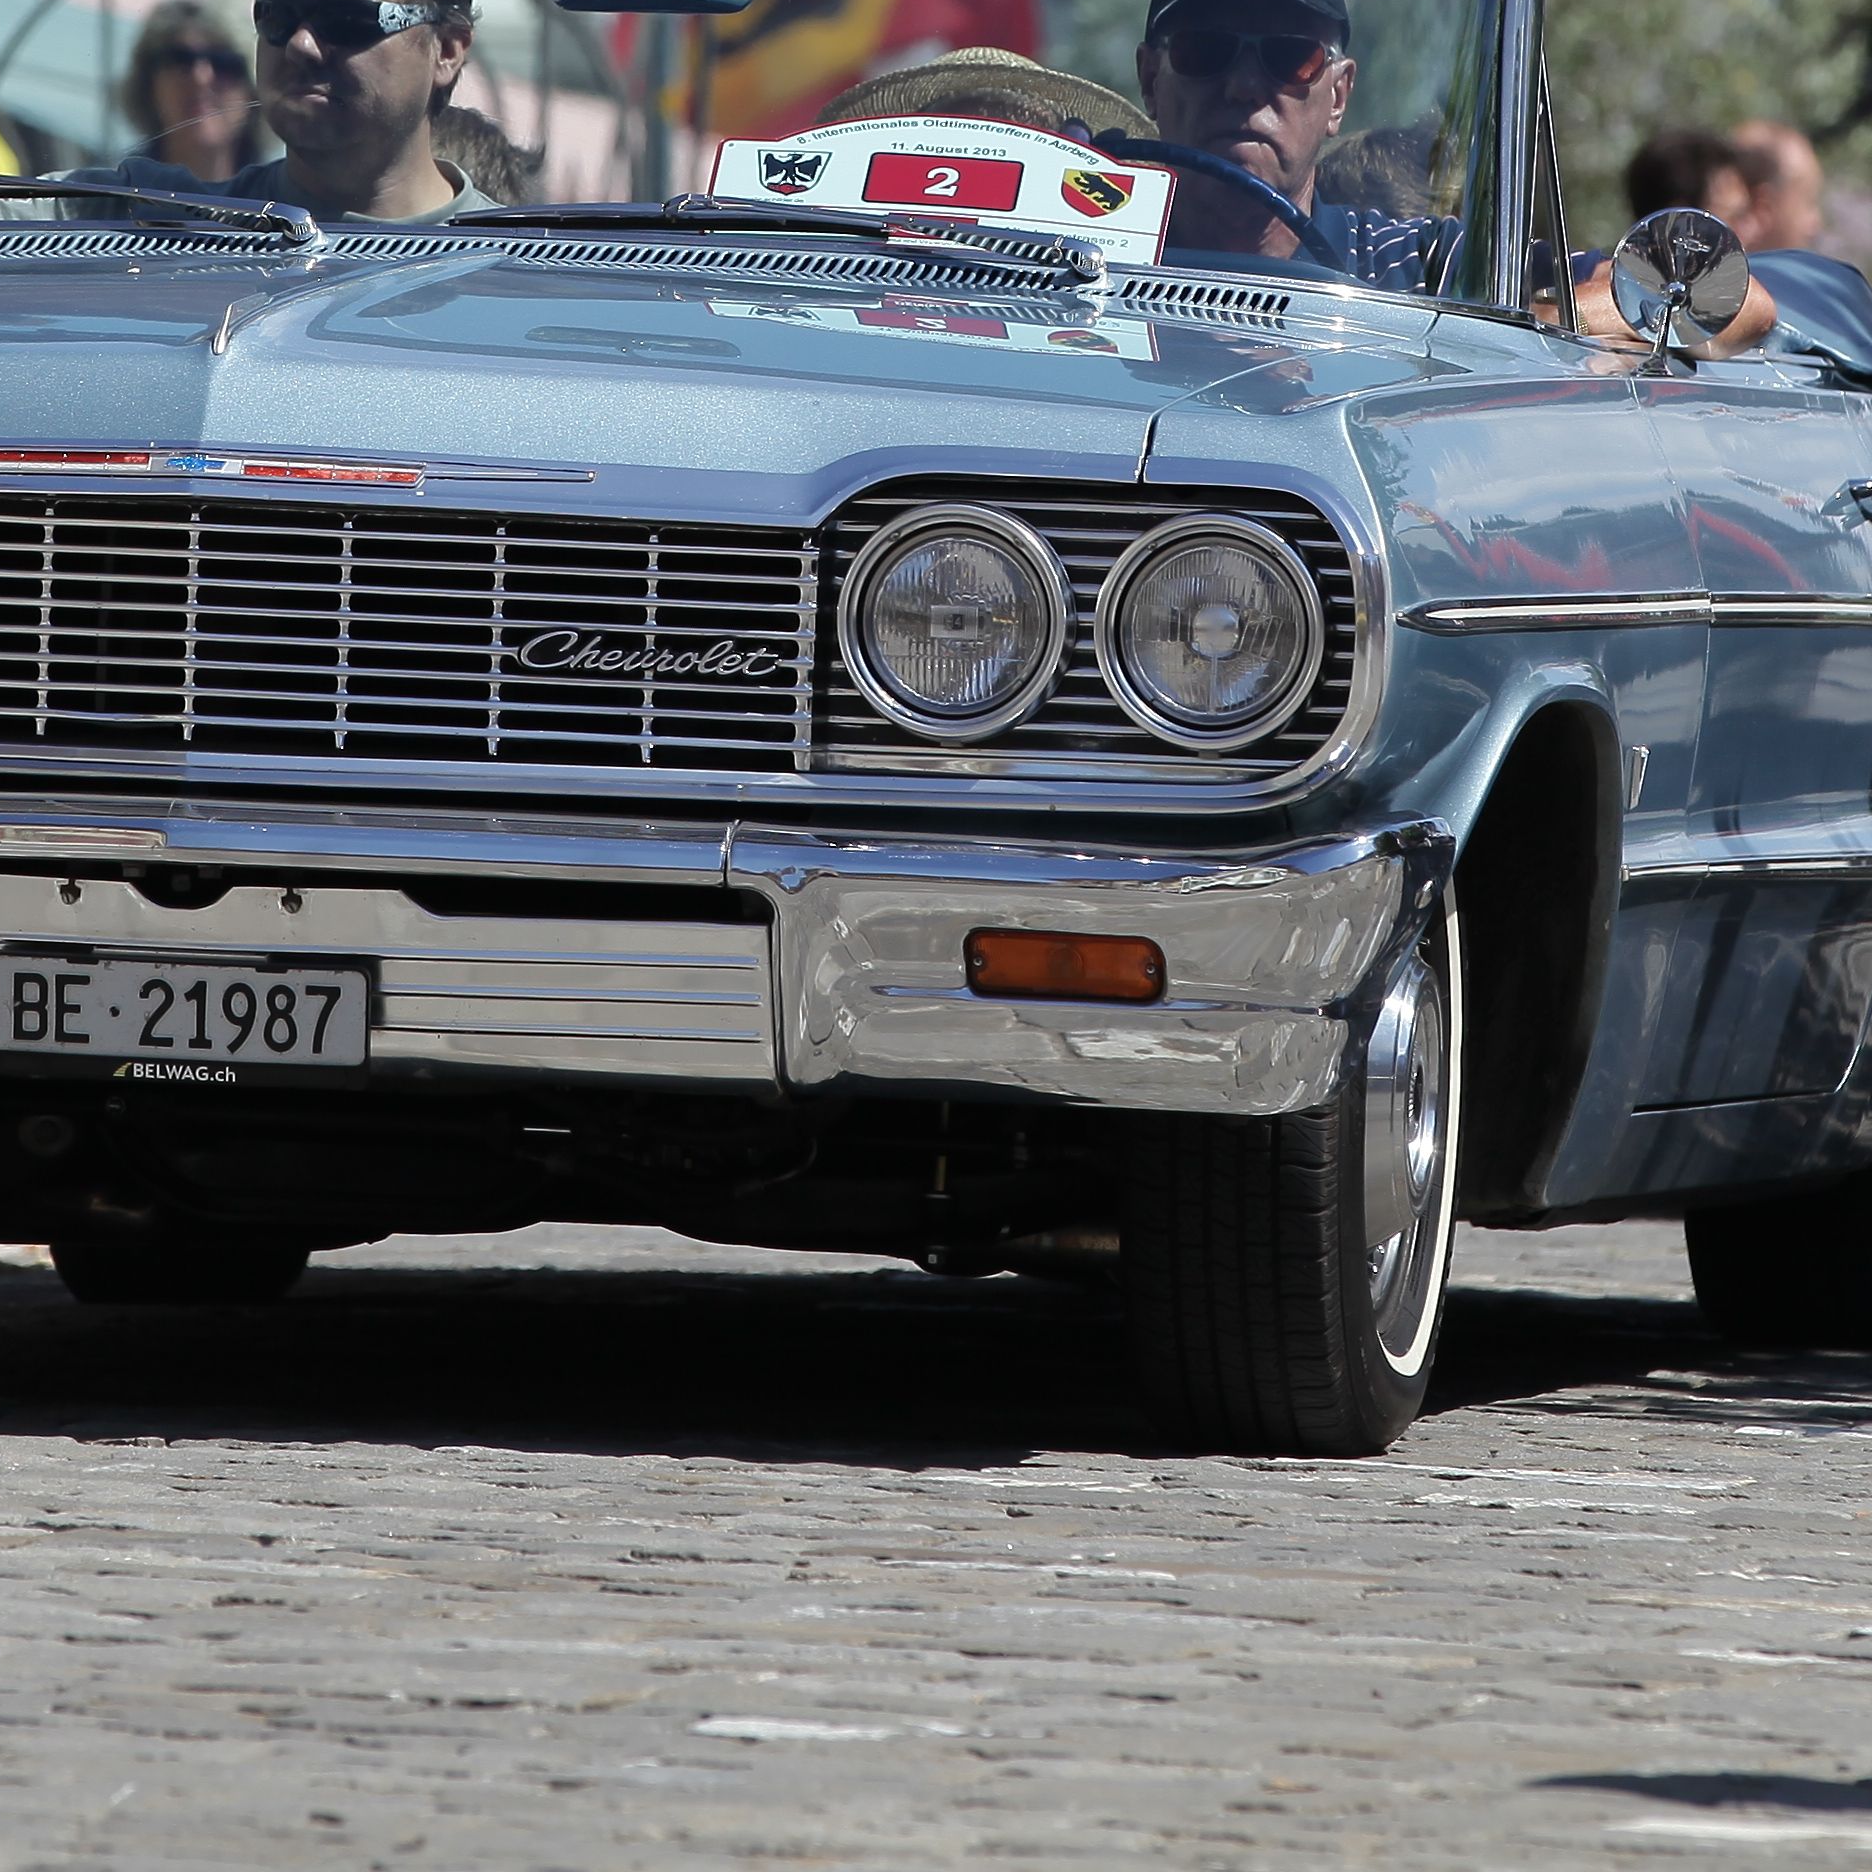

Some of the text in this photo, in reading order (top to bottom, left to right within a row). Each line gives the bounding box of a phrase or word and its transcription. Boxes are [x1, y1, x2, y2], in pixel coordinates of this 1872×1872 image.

[812, 119, 919, 140] Internationales
[923, 119, 1031, 140] Oldtimertreffen
[1034, 133, 1048, 145] in
[1048, 139, 1100, 166] Aarberg
[891, 142, 1007, 157] 11. August 2013
[923, 166, 961, 197] 2
[519, 630, 779, 676] Chevrolet
[12, 972, 342, 1055] BE 21987
[133, 1062, 236, 1083] BELWAG.ch
